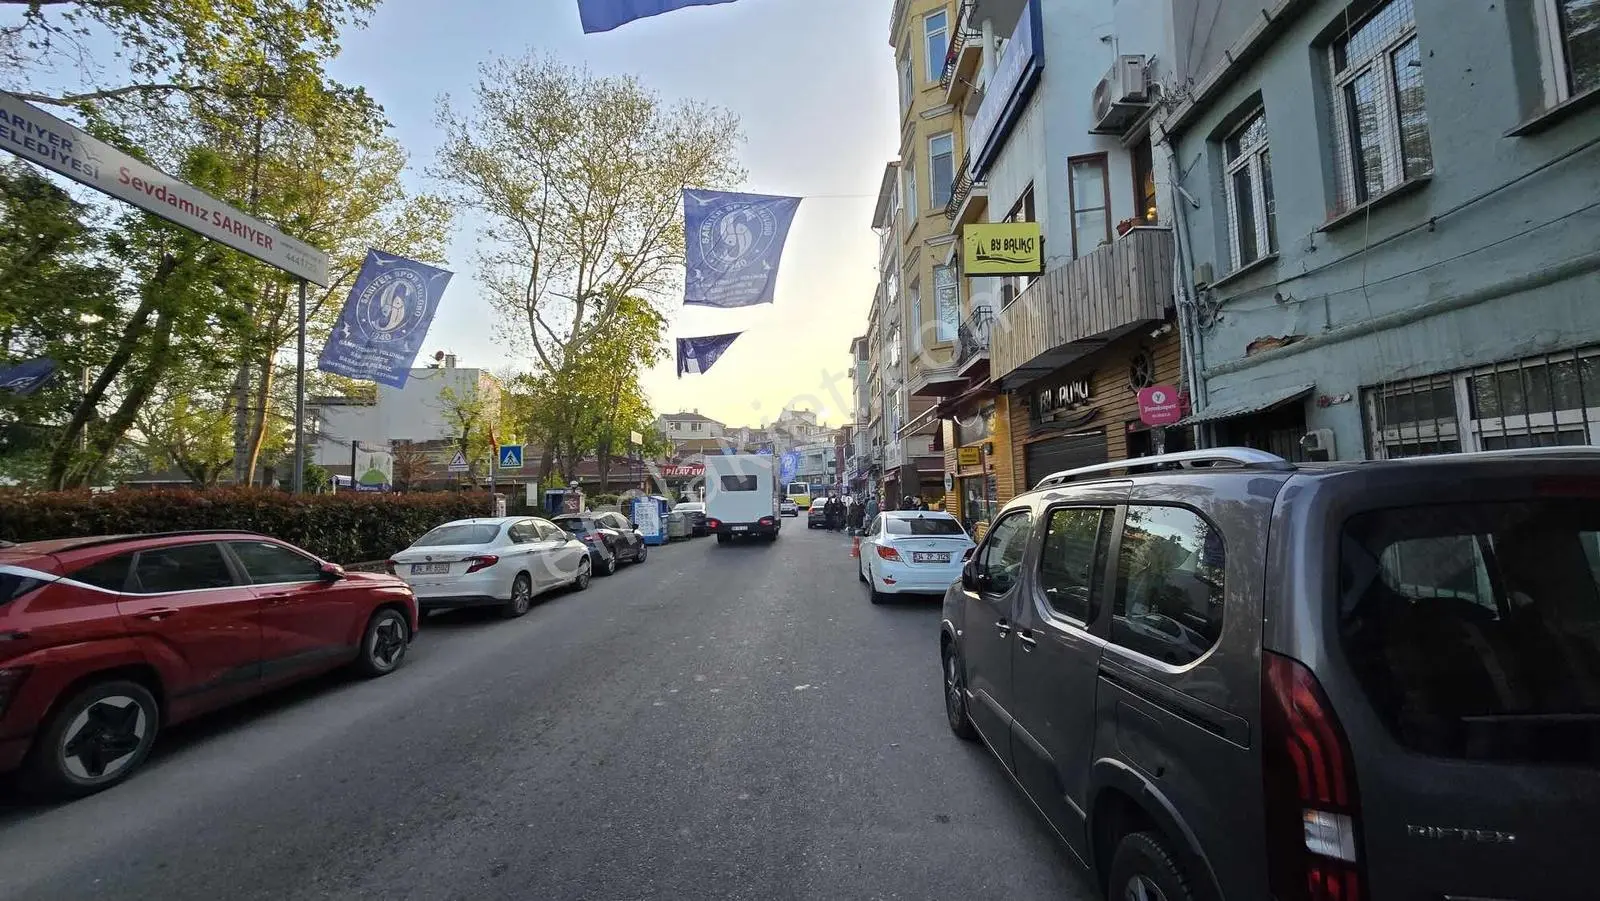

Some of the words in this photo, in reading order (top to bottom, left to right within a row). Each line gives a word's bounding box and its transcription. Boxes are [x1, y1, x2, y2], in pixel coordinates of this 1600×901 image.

[118, 166, 209, 221] Sevdamız
[212, 211, 273, 250] SARIYER
[991, 238, 1001, 251] BY
[1003, 237, 1034, 254] BALIKÇI
